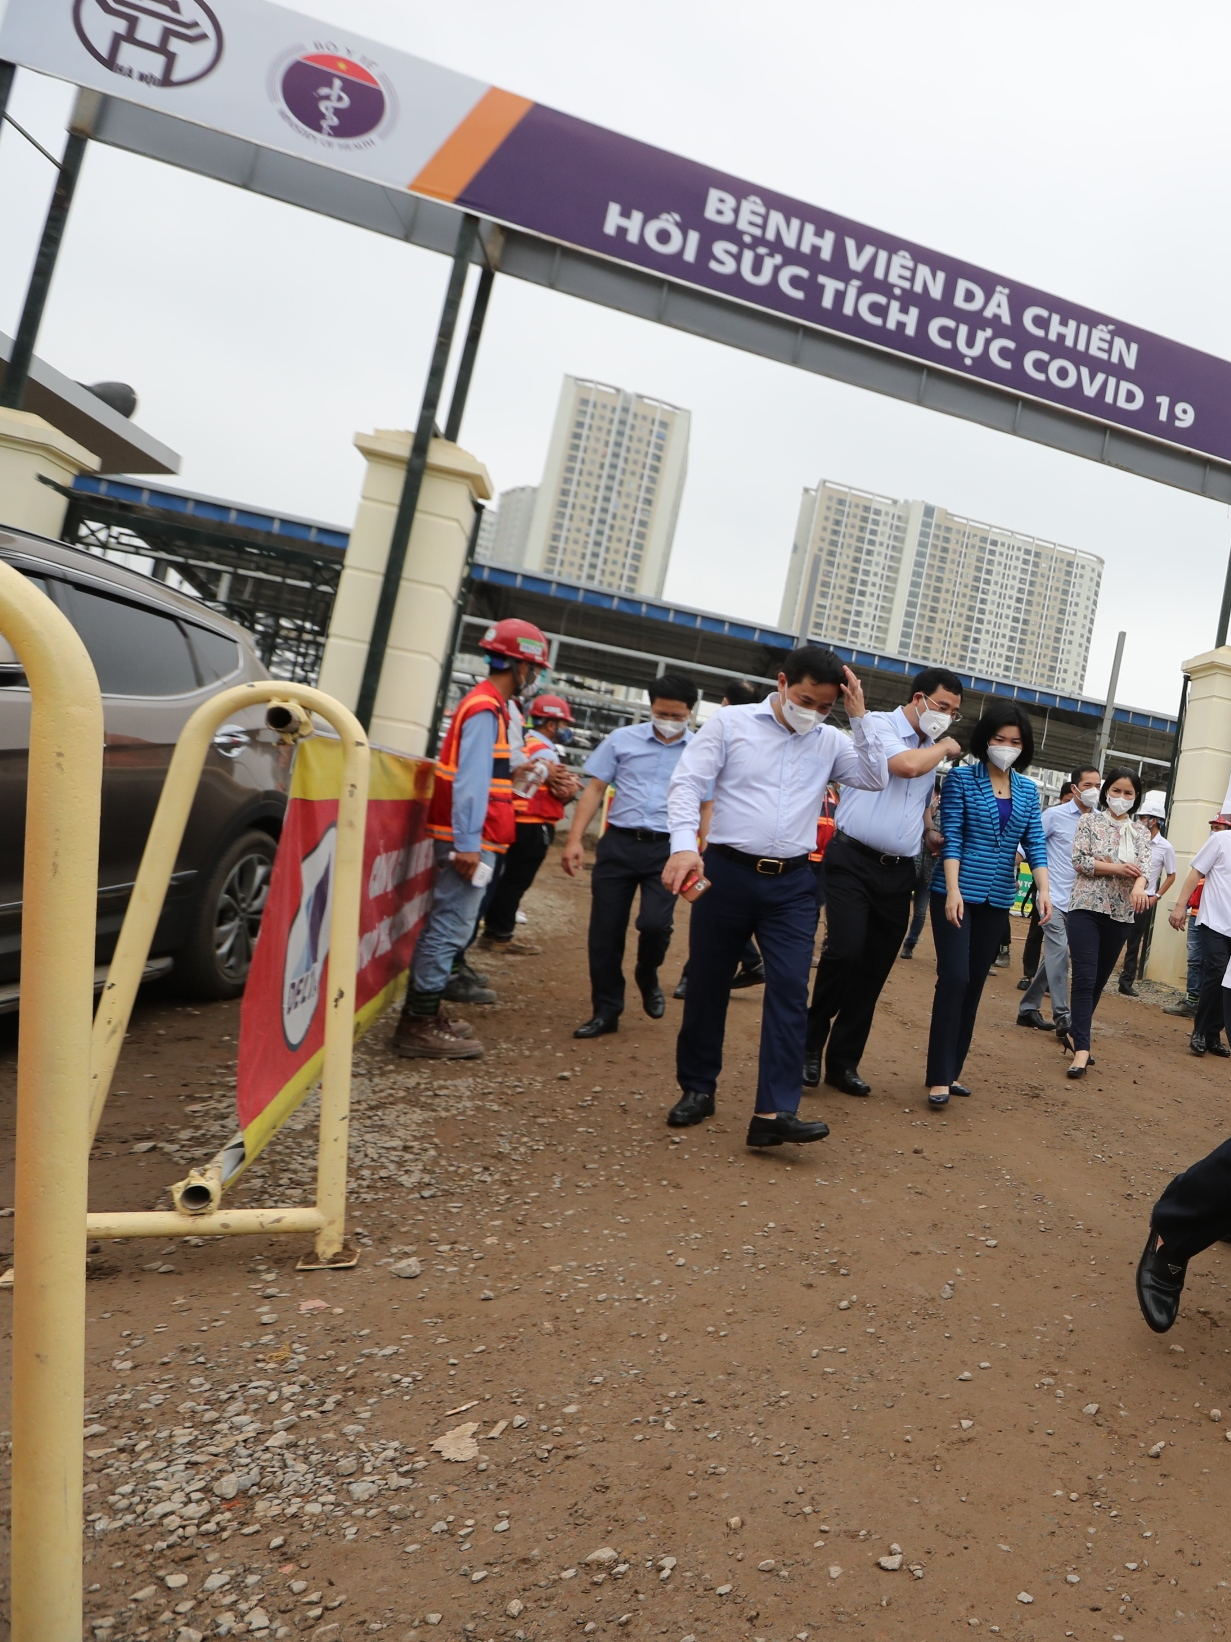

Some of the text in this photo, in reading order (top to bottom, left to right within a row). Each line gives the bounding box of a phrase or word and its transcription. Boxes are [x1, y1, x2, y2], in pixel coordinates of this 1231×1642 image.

[603, 201, 1196, 429] HỒI SỨC TÍCH CỰC COVID 19
[704, 187, 1139, 370] BỆNH VIỆN DÃ CHIẾN
